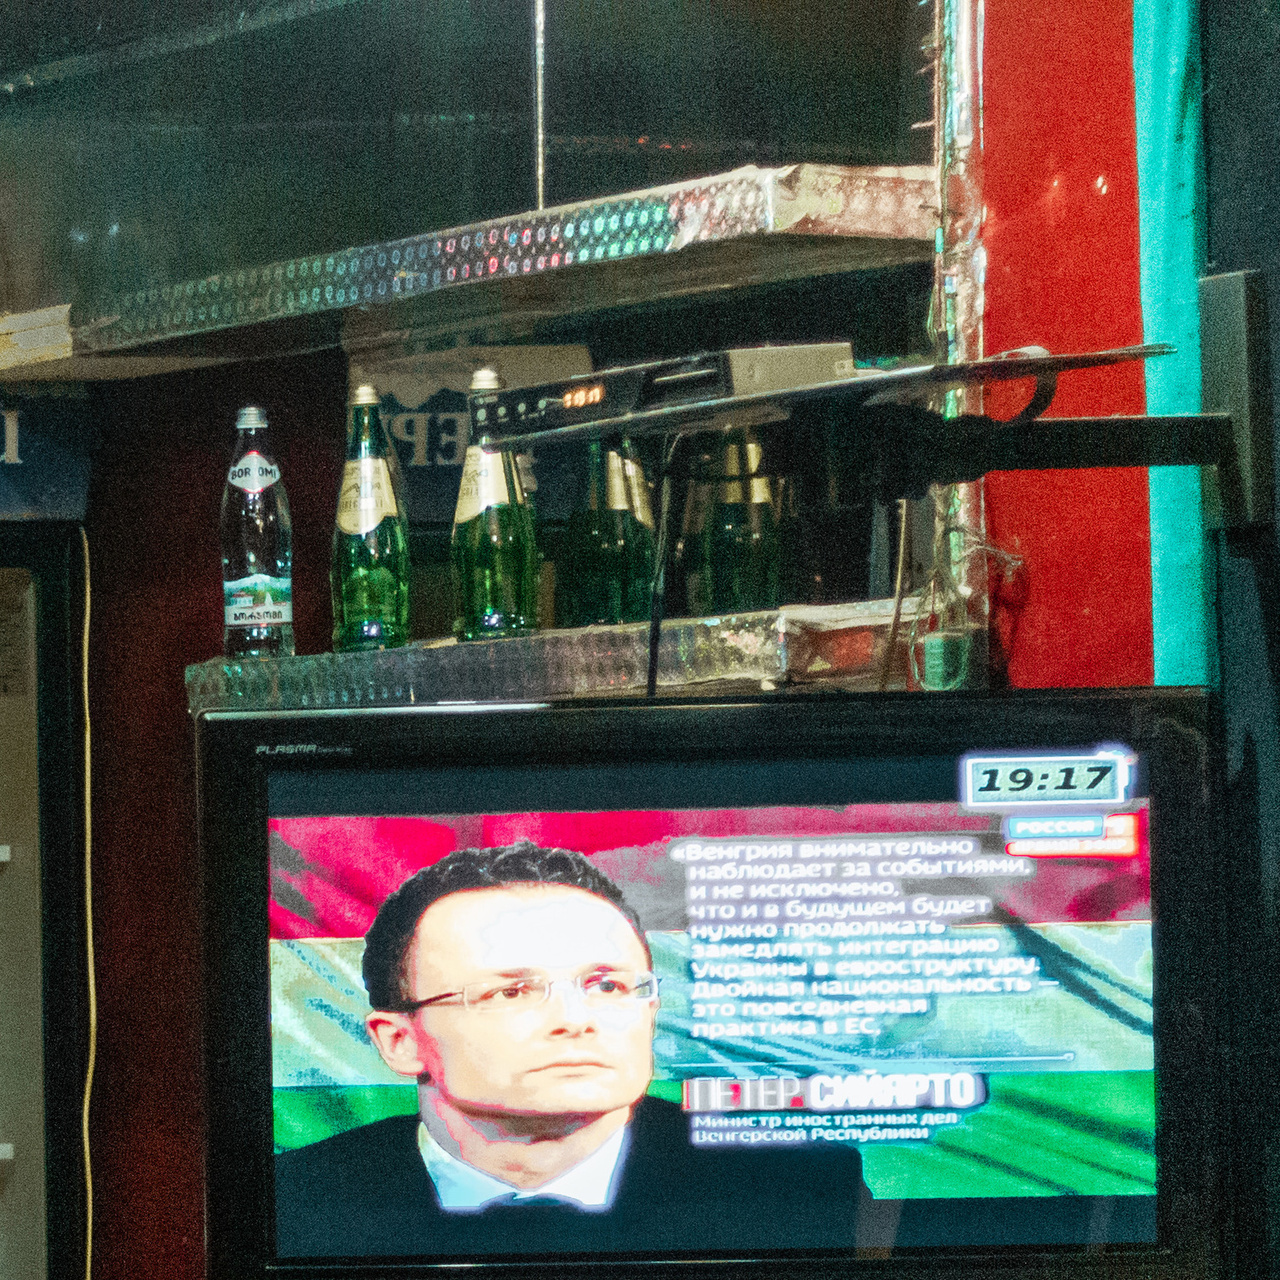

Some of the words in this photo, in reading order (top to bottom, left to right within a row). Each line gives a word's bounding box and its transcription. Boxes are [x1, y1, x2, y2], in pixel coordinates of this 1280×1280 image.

[230, 466, 277, 480] BOROMI
[255, 744, 317, 755] PLASMA
[977, 766, 1113, 792] 19:17
[1016, 820, 1096, 834] РОССИЯ
[671, 843, 794, 861] «Венгрия
[800, 839, 974, 859] внимательно
[689, 861, 836, 880] наблюдает
[841, 860, 871, 877] за
[689, 885, 706, 900] и
[712, 884, 744, 900] не
[750, 880, 900, 898] исключено,
[690, 903, 737, 919] что
[741, 903, 758, 918] и
[764, 903, 780, 918] в
[785, 899, 906, 919] будущем
[912, 897, 990, 915] будет
[690, 923, 778, 942] нужно
[783, 919, 946, 938] продолжать
[691, 943, 833, 959] замедлять
[838, 938, 1000, 957] интеграцию
[691, 961, 808, 980] Украины
[814, 960, 829, 976] в
[835, 956, 1041, 978] евроструктуру.
[690, 980, 805, 999] Двойная
[811, 977, 1033, 996] национальность
[692, 1002, 736, 1018] это
[742, 999, 928, 1017] повседневная
[692, 1020, 817, 1040] практика
[823, 1019, 839, 1036] в
[694, 1075, 801, 1110] ПЕТЕР
[693, 1113, 782, 1129] Министр
[784, 1112, 918, 1128] иностранных
[920, 1112, 958, 1126] дел
[695, 1127, 807, 1143] Венгерской
[811, 1126, 929, 1143] Республики
